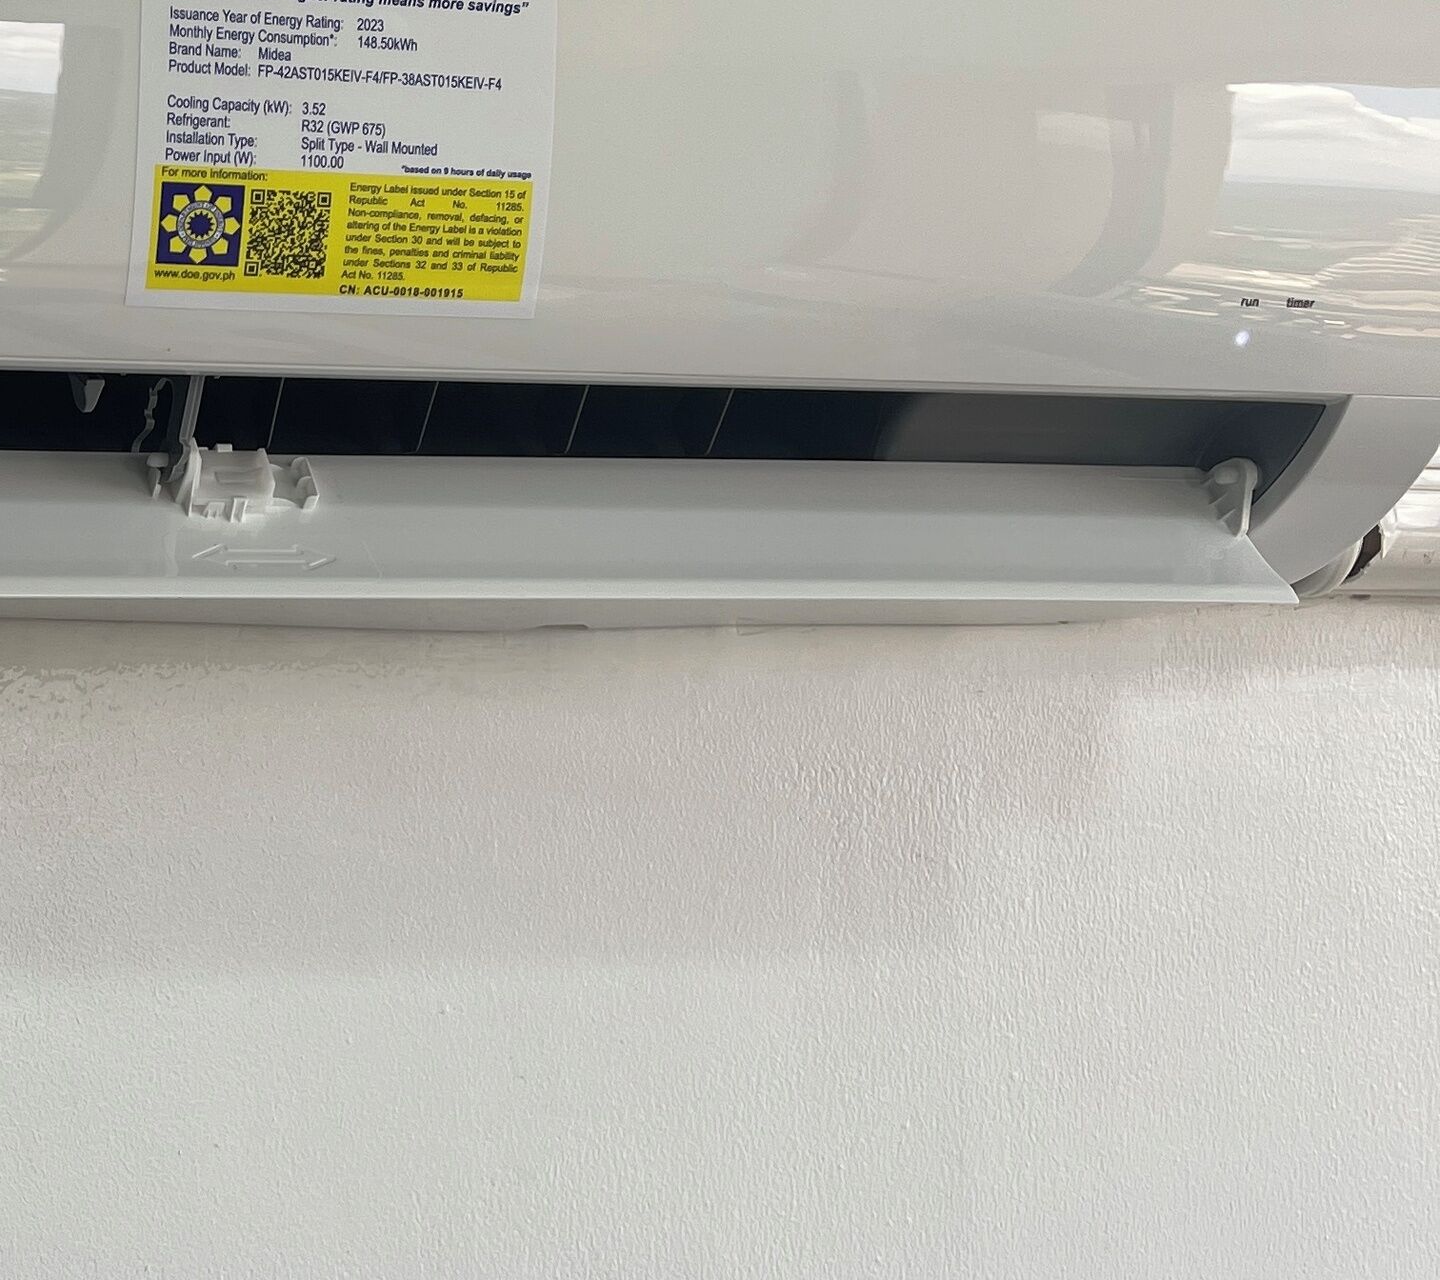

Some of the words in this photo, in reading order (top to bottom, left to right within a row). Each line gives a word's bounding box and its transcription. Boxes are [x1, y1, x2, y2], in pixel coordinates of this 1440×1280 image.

[170, 6, 219, 22] Issuance
[222, 9, 248, 24] Year
[250, 12, 261, 24] of
[265, 12, 302, 28] Energy
[306, 15, 344, 32] Rating:
[357, 18, 384, 32] 2023
[170, 24, 212, 41] Monthly
[216, 27, 255, 44] Energy
[358, 36, 418, 52] 148.50kWh
[169, 42, 202, 56] Brand
[206, 44, 241, 58] Name:
[258, 47, 292, 61] Midea
[169, 59, 211, 73] Product
[214, 62, 251, 77] Model:
[258, 64, 502, 91] FP-42AST015KEIV-F4/FP-38AST015KEIV-F4
[167, 94, 209, 112] Cooling
[212, 97, 260, 115] Capacity
[264, 99, 292, 116] (kW):
[302, 102, 326, 115] 3.52
[167, 112, 231, 129] Refrigerant:
[302, 120, 323, 133] R32
[327, 121, 360, 137] (GWP
[362, 123, 386, 138] 675)
[166, 130, 224, 146] Installation
[228, 133, 257, 149] Type:
[301, 137, 324, 153] Split
[328, 139, 354, 154] Type
[365, 141, 388, 153] Wall
[392, 142, 437, 155] Mounted
[165, 148, 200, 162] Power
[204, 151, 231, 165] Input
[234, 151, 257, 167] (W):
[301, 155, 344, 168] 1100.00
[162, 166, 179, 176] For
[182, 168, 207, 178] more
[210, 168, 268, 181] information:
[451, 168, 474, 176] hours
[476, 168, 484, 176] of
[486, 169, 505, 179] daily
[508, 171, 531, 180] usage
[350, 182, 382, 194] Energy
[384, 184, 408, 193] Label
[410, 186, 439, 195] issued
[442, 187, 467, 196] under
[469, 188, 502, 198] Section
[505, 190, 515, 199] 15
[517, 190, 526, 199] of
[349, 195, 388, 206] Republic
[410, 198, 425, 207] Act
[453, 200, 467, 209] No.
[496, 202, 524, 212] 11285.
[348, 208, 421, 221] Non-compliance,
[427, 211, 464, 221] removal,
[470, 213, 509, 225] defacing,
[514, 216, 524, 224] or
[347, 220, 380, 232] altering
[382, 222, 391, 230] of
[393, 222, 407, 231] the
[409, 223, 440, 235] Energy
[443, 224, 467, 234] Label
[469, 225, 476, 234] is
[487, 226, 522, 236] violation
[346, 233, 371, 242] under
[375, 234, 408, 244] Section
[411, 236, 423, 244] 30
[426, 237, 443, 245] and
[446, 237, 461, 246] will
[464, 238, 475, 247] be
[478, 239, 509, 249] subject
[512, 240, 521, 248] to
[345, 246, 359, 254] the
[362, 246, 385, 256] fines,
[389, 248, 429, 258] penalties
[432, 249, 449, 257] and
[452, 250, 487, 259] criminal
[490, 252, 520, 262] liability
[343, 258, 369, 267] under
[373, 259, 411, 269] Sections
[415, 260, 426, 269] 32
[430, 261, 447, 270] and
[452, 262, 463, 271] 33
[467, 263, 477, 271] of
[480, 263, 518, 274] Republic
[154, 269, 236, 282] www.doe.gov.ph
[341, 270, 357, 279] Act
[359, 271, 373, 280] No.
[377, 272, 405, 281] 11285.
[339, 284, 360, 295] CN:
[1241, 297, 1259, 307] run
[1286, 298, 1315, 308] timer
